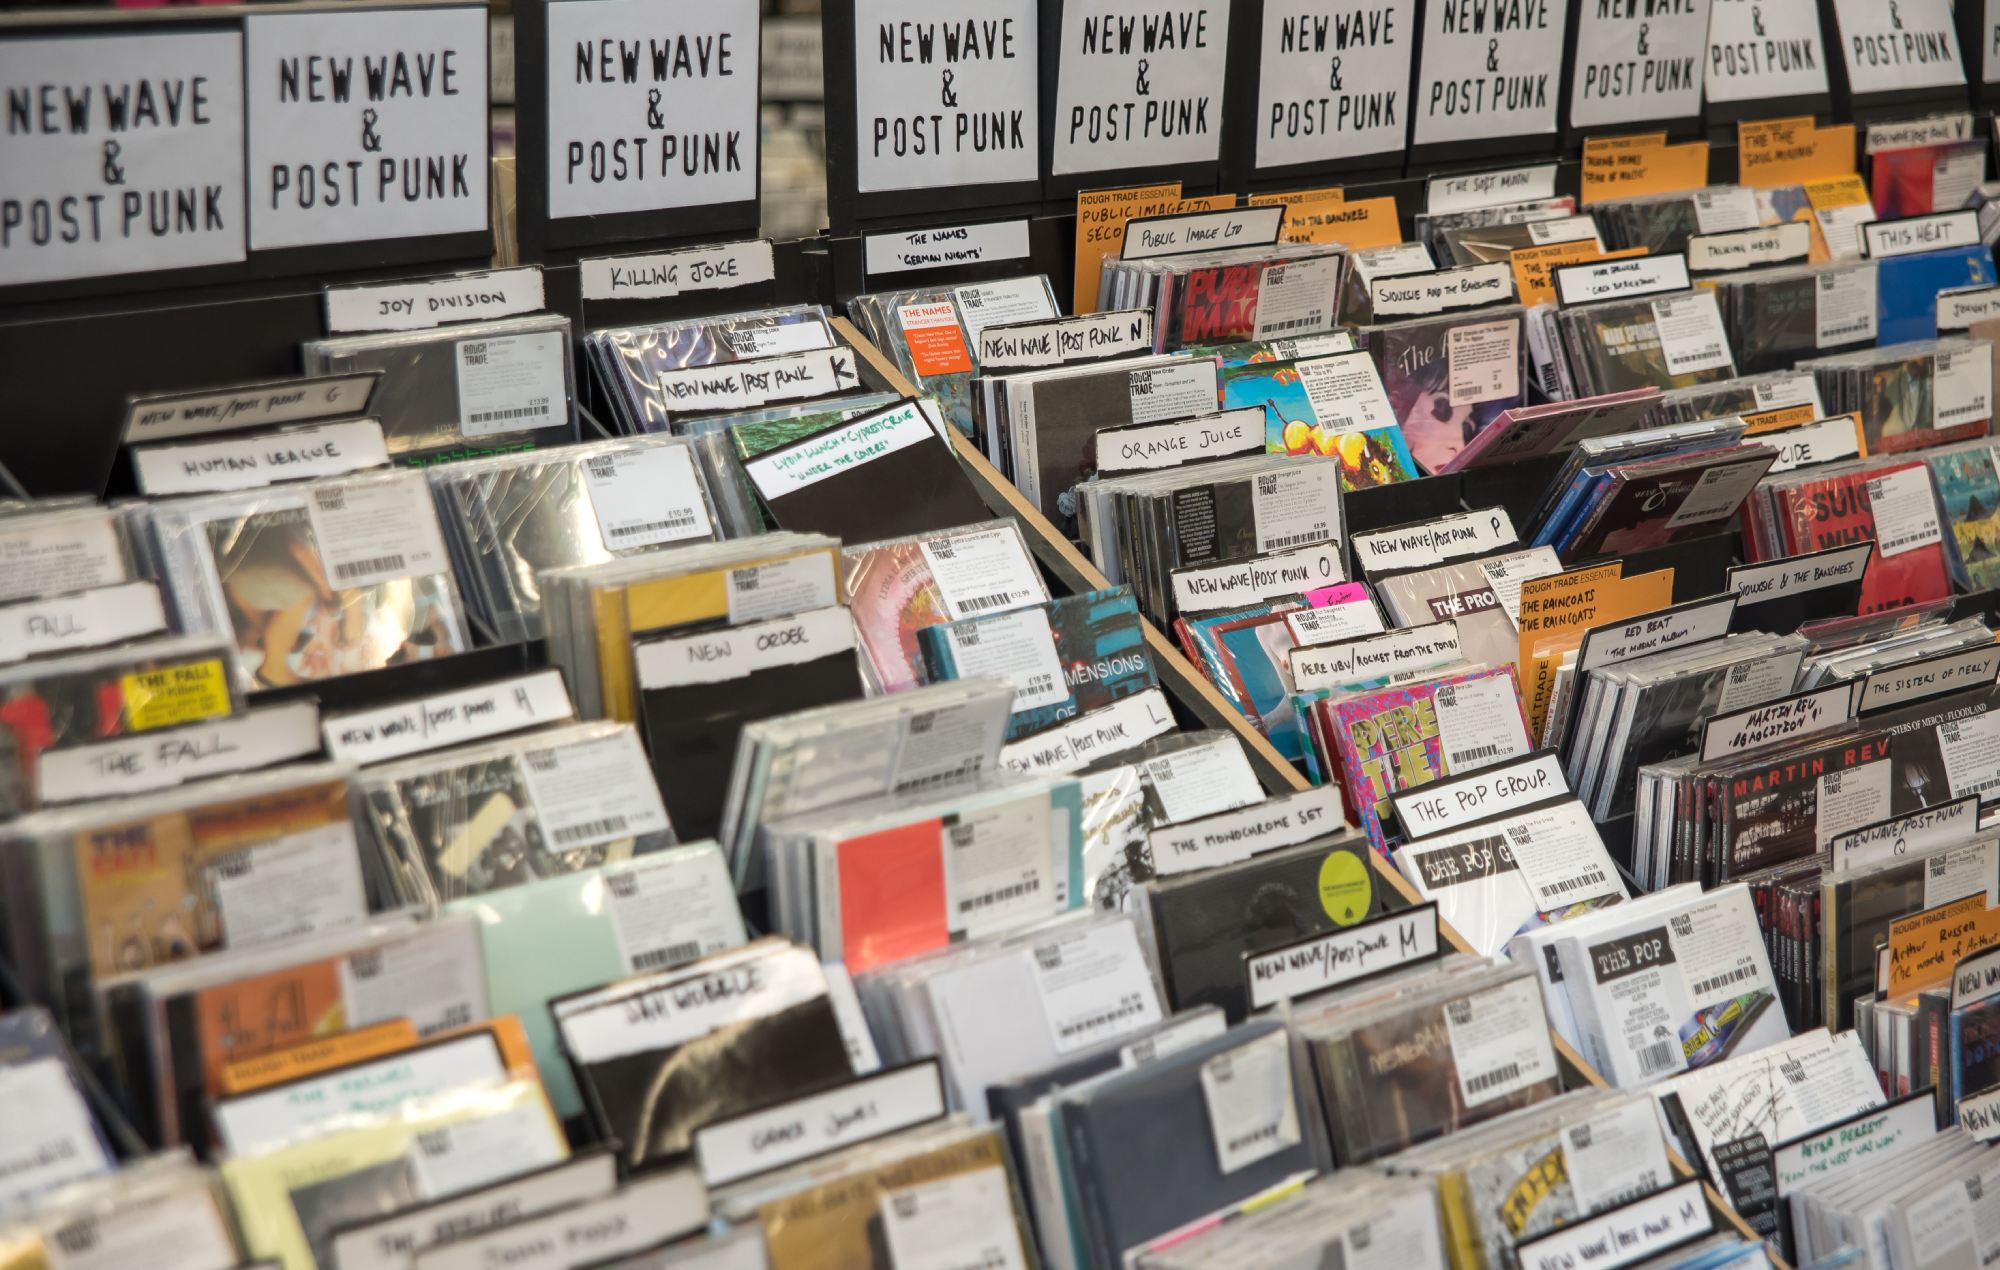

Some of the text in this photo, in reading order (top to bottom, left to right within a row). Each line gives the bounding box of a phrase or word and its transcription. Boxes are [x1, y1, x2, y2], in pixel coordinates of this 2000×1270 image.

[1083, 10, 1206, 55] NEW WAVE
[1282, 8, 1394, 53] NEW WAVE
[1443, 0, 1548, 34] NEW WAVE
[880, 18, 1015, 63] NEW WAVE
[1853, 31, 1952, 66] POST PUNK
[576, 33, 733, 84] NEW WAVE
[1711, 39, 1816, 76] POST PUNK
[281, 50, 458, 103] NEW WAVE
[1135, 59, 1149, 95] &
[1584, 57, 1695, 99] POST PUNK
[8, 77, 211, 134] NEW WAVE
[648, 89, 664, 129] &
[1430, 74, 1548, 116] POST PUNK
[1070, 97, 1209, 144] POST PUNK
[1271, 91, 1396, 139] POST PUNK
[874, 109, 1024, 157] POST PUNK
[1745, 131, 1794, 148] THE THE
[103, 140, 125, 185] &
[568, 131, 740, 184] POST PUNK
[272, 154, 469, 210] POST PUNK
[1081, 187, 1180, 206] ROUGH TRADE ESSENTIAL
[1446, 181, 1469, 195] THE
[2, 185, 223, 248] POST PUNK
[906, 228, 968, 245] THE NAMES
[1142, 221, 1243, 248] PUBLIC IMAGE LTD
[1707, 240, 1780, 257] TALKING HEADS
[1878, 222, 1952, 248] THIS HEAT
[611, 258, 738, 291] KILLING JOKE
[1524, 263, 1543, 274] THE
[379, 291, 506, 316] JOY DIVISION
[960, 289, 981, 300] ROUGH
[963, 299, 984, 309] TRADE
[1379, 277, 1501, 303] SIOUXSIE AND THE BANSHEES
[903, 306, 952, 318] THE NAMES
[464, 343, 487, 355] ROUGH
[465, 355, 488, 366] TRADE
[1398, 346, 1436, 377] The
[1130, 371, 1152, 384] ROUGH
[1131, 384, 1153, 396] TRADE
[184, 442, 341, 476] HUMAN LEAGUE
[1121, 427, 1242, 460] ORANGE JUICE
[1187, 578, 1217, 595] NEW
[1282, 567, 1309, 583] PUNK
[1523, 568, 1619, 595] ROUGH TRADE ESSENTIAL
[1738, 562, 1854, 597] SIOUXSIE & THE BANSHEES
[1521, 589, 1596, 614] THE RAINCOATS
[27, 613, 86, 635] FALL
[1624, 616, 1672, 637] RED BEAT
[687, 626, 809, 663] NEW ORDER
[1301, 662, 1327, 676] PERE
[1394, 648, 1415, 661] FROM
[1415, 646, 1433, 657] THE
[136, 664, 215, 688] THE FALL
[1873, 659, 1990, 694] THE SISTERS OF MERCY
[1351, 697, 1440, 760] PERE
[1745, 699, 1816, 729] MARTIN REV
[342, 726, 373, 744] NEW
[88, 733, 240, 777] THE FALL
[1734, 739, 1888, 798] MARTIN REV
[1412, 768, 1551, 821] THE POP GROUP.
[1171, 807, 1323, 856] THE MONOCHROME SET
[1426, 848, 1493, 880] THE POP
[1893, 901, 1984, 936] ROUGH TRADE ESSENTIAL
[1599, 939, 1662, 974] THE POP
[1891, 941, 1926, 964] Arthur
[1891, 933, 1998, 984] The world of Arthur
[1959, 972, 1980, 996] NEW
[1963, 1108, 1989, 1131] NEW
